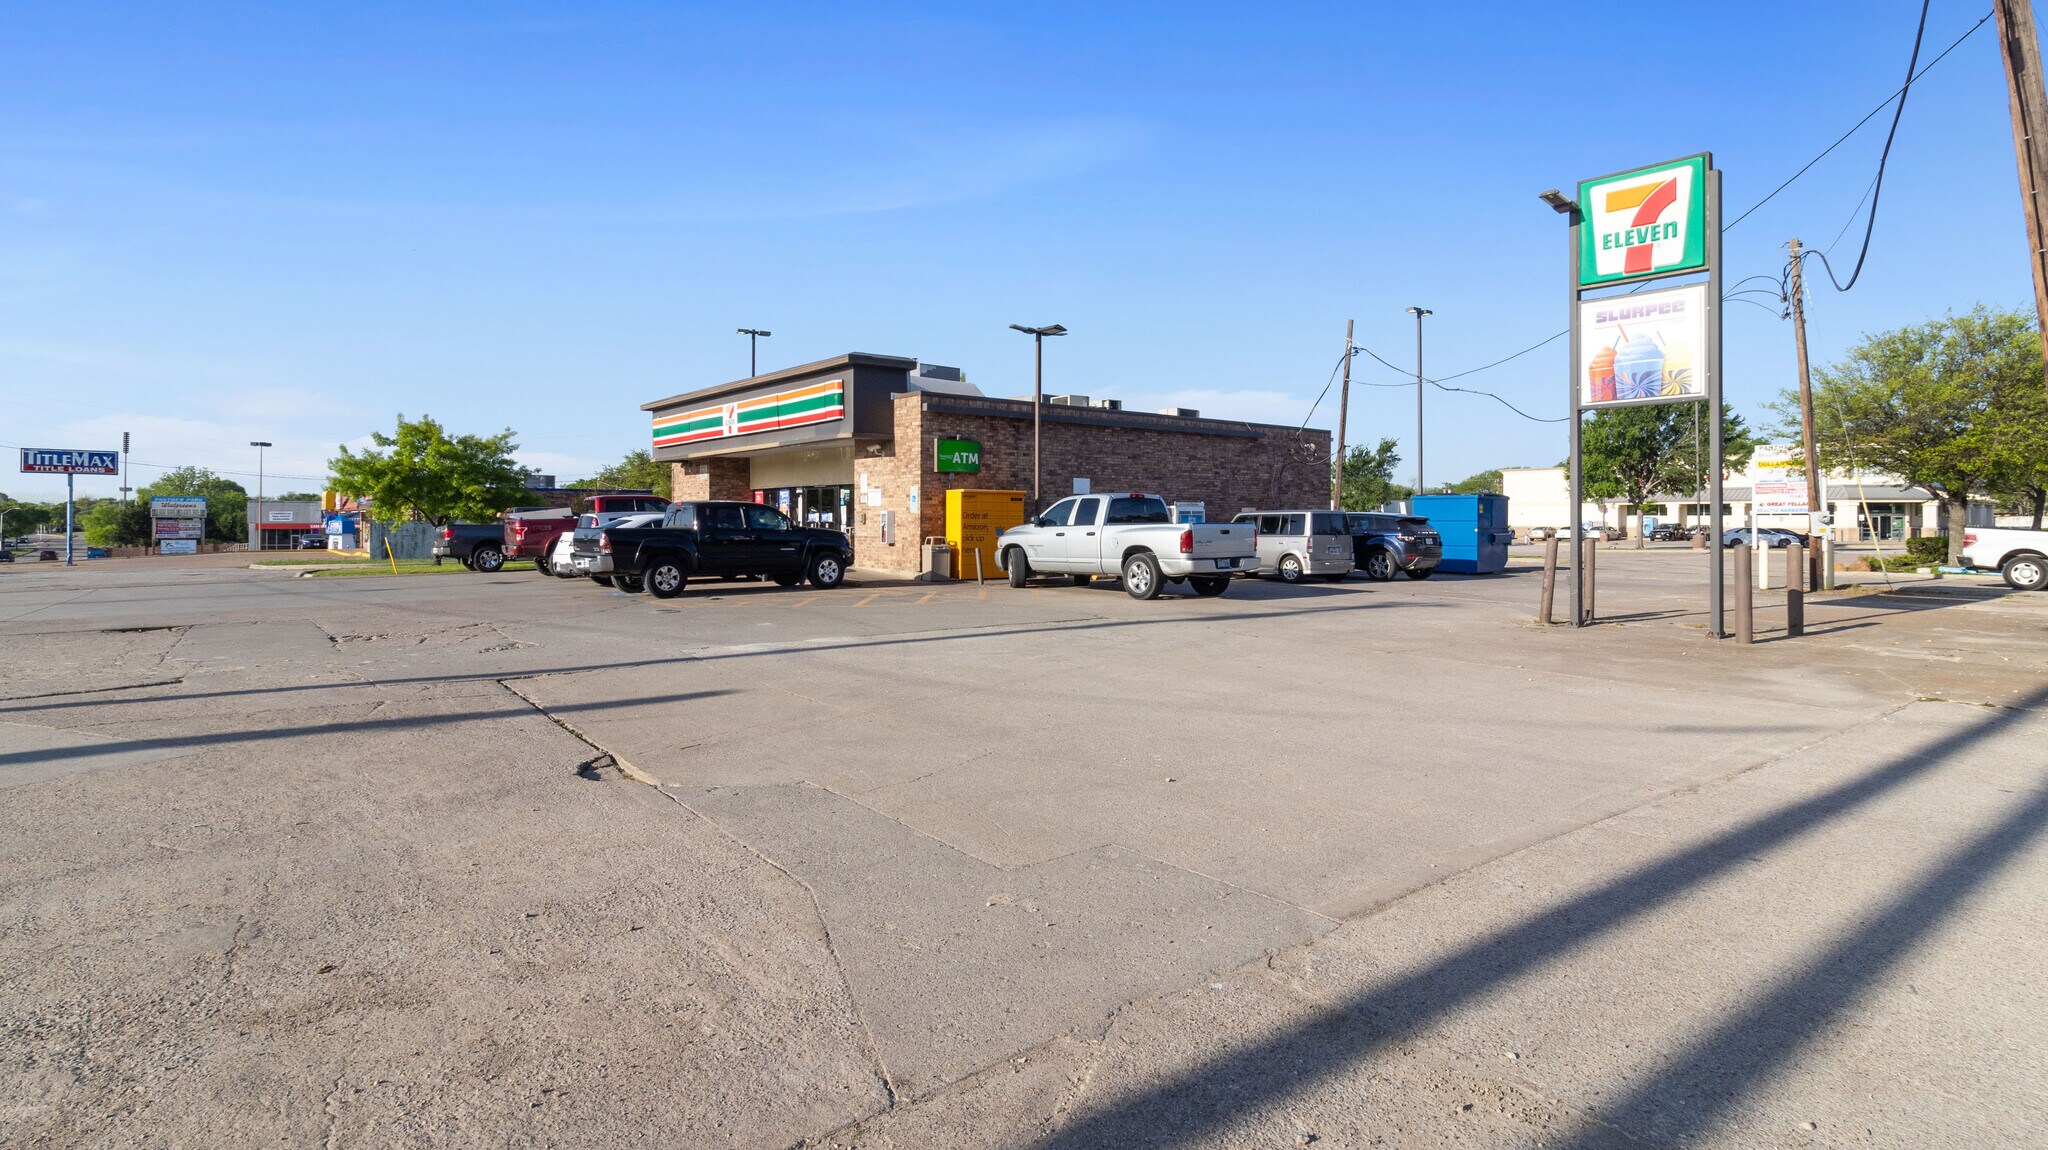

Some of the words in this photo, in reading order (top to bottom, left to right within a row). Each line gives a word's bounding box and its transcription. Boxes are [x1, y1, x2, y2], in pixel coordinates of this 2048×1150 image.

[1605, 177, 1677, 274] 7
[952, 452, 979, 465] ATM
[962, 511, 981, 520] Order
[981, 512, 989, 520] at
[962, 524, 989, 532] Amazon,
[962, 535, 975, 543] pick
